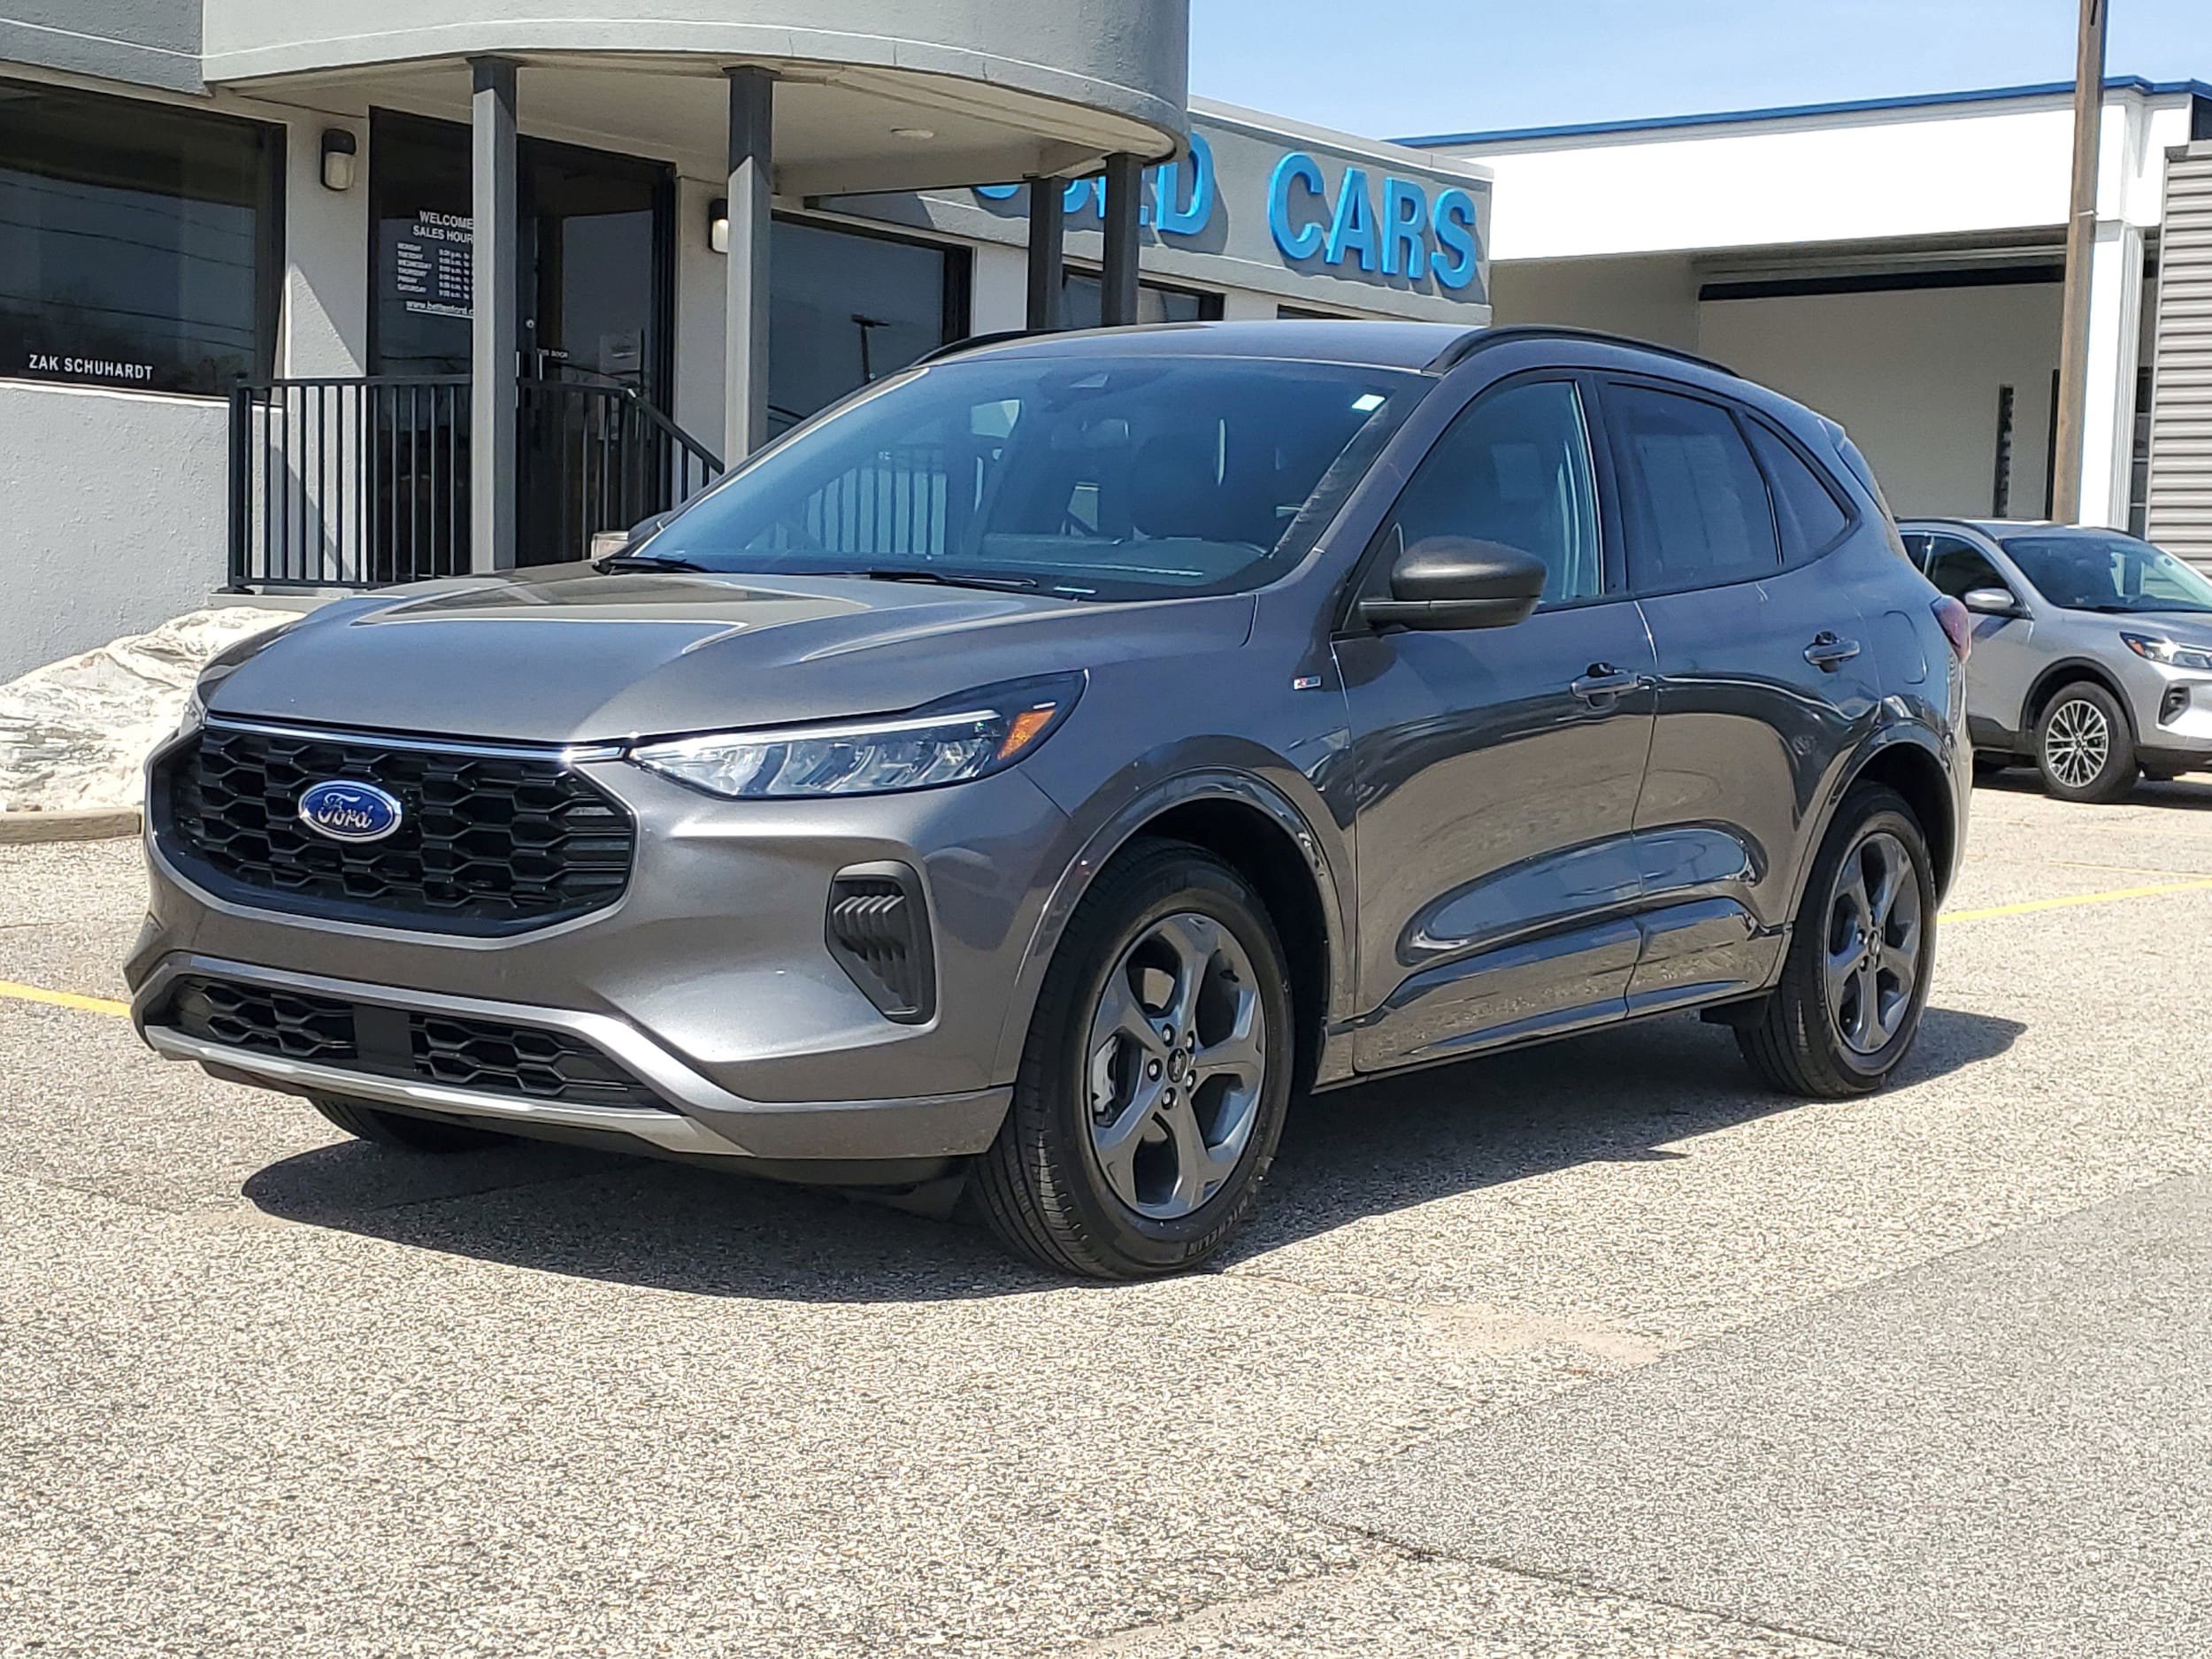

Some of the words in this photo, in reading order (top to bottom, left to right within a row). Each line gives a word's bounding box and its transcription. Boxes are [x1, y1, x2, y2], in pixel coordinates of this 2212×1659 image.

[419, 210, 474, 229] WELCOME
[1267, 151, 1477, 289] CARS
[412, 225, 445, 240] SALES
[447, 231, 474, 244] HOUR
[28, 354, 59, 371] ZAK
[64, 357, 153, 380] SCHUHARDT
[318, 792, 374, 828] Ford
